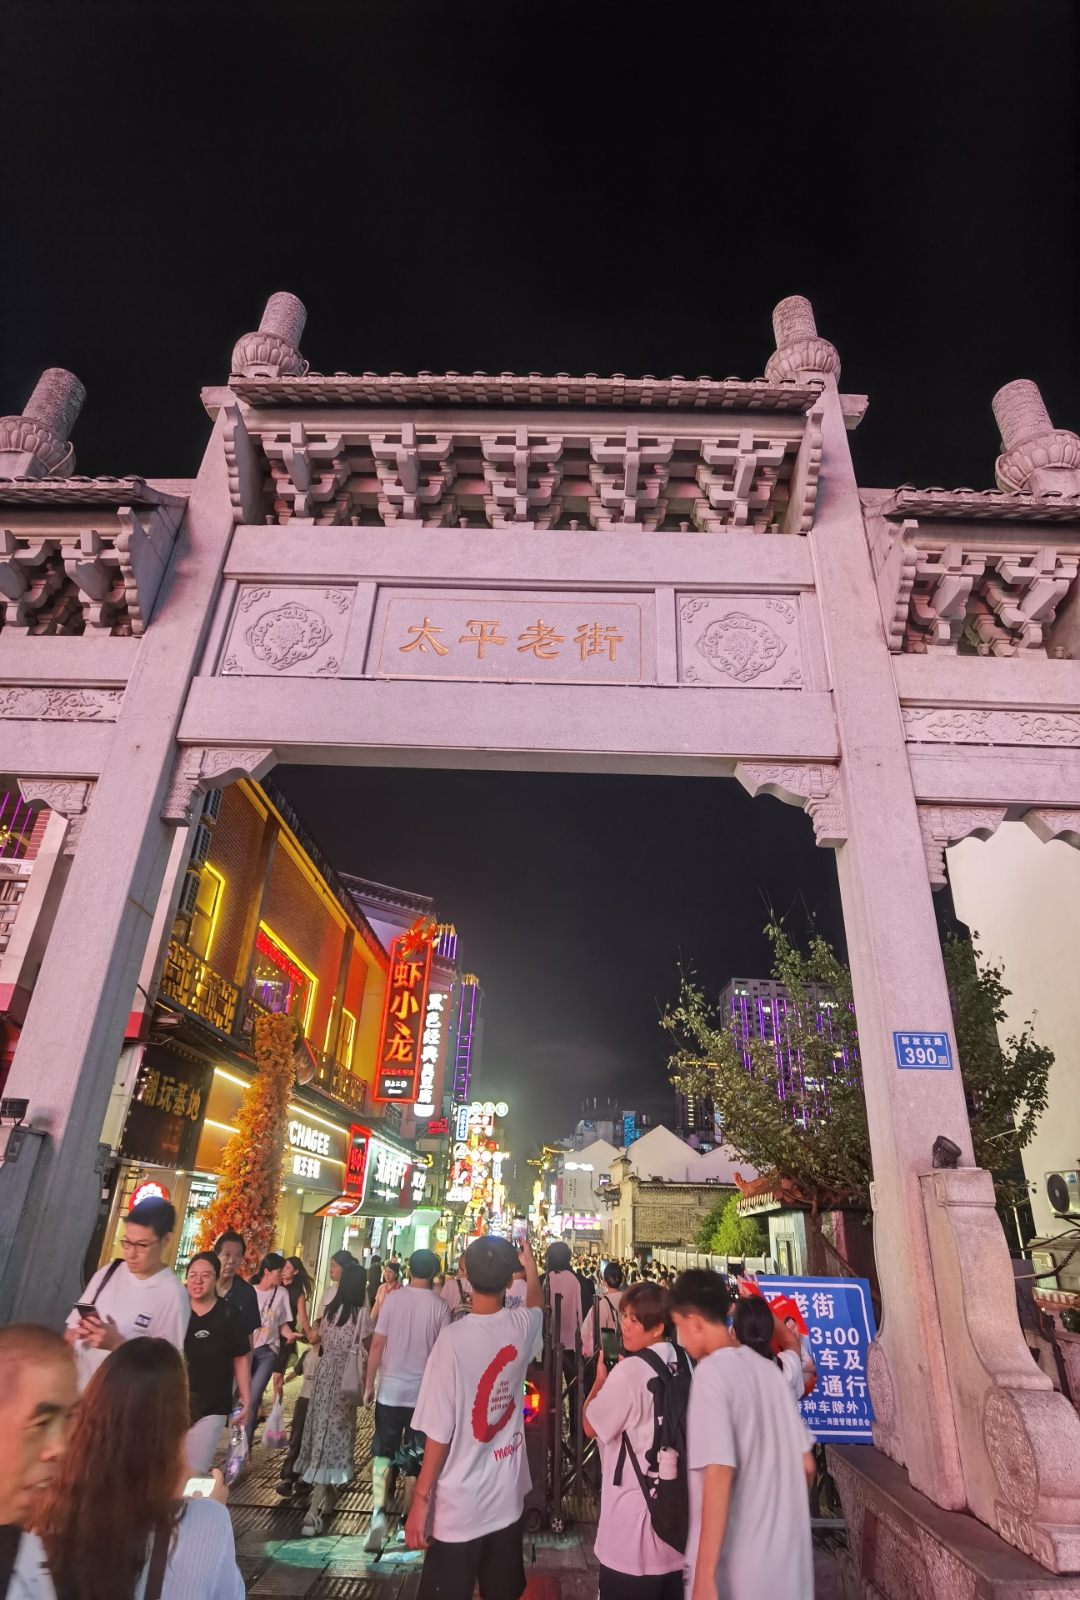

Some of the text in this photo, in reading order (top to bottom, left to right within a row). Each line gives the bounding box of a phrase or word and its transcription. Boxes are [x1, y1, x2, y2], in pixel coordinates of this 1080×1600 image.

[399, 617, 624, 661] 太平老街
[382, 960, 424, 1062] 虾小龙
[905, 1047, 937, 1064] 390
[137, 1066, 201, 1121] 潮玩基地
[288, 1120, 331, 1156] CHAGEE
[812, 1348, 864, 1371] 车及
